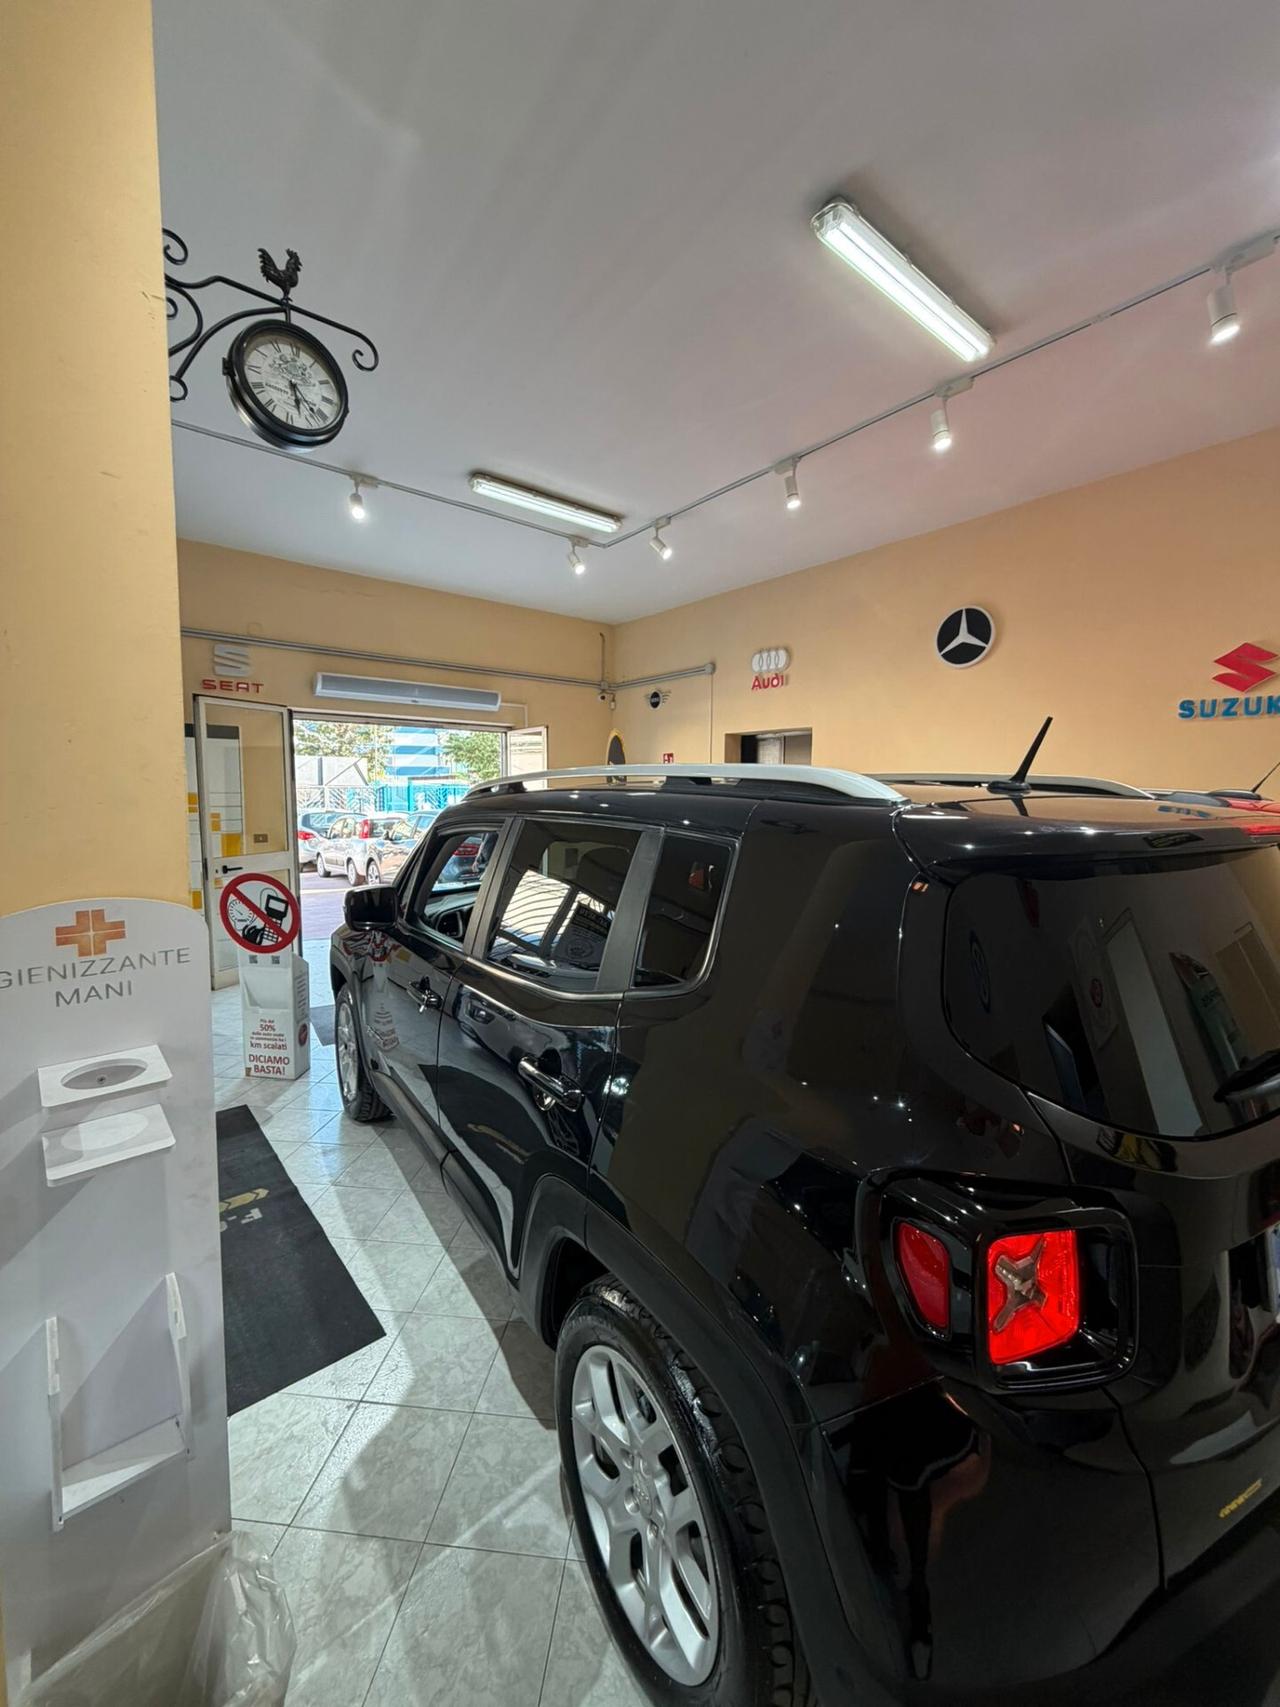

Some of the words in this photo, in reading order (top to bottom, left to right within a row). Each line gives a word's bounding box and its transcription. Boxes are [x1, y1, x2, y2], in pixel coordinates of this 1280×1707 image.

[202, 679, 264, 693] SEAT
[751, 673, 784, 690] Audi
[0, 947, 191, 989] GIENIZZANTE
[55, 980, 132, 1007] MANI
[259, 1024, 276, 1032] 50%
[263, 1043, 288, 1051] scalati
[248, 1054, 290, 1065] DICIAMO
[253, 1064, 285, 1076] BASTA!
